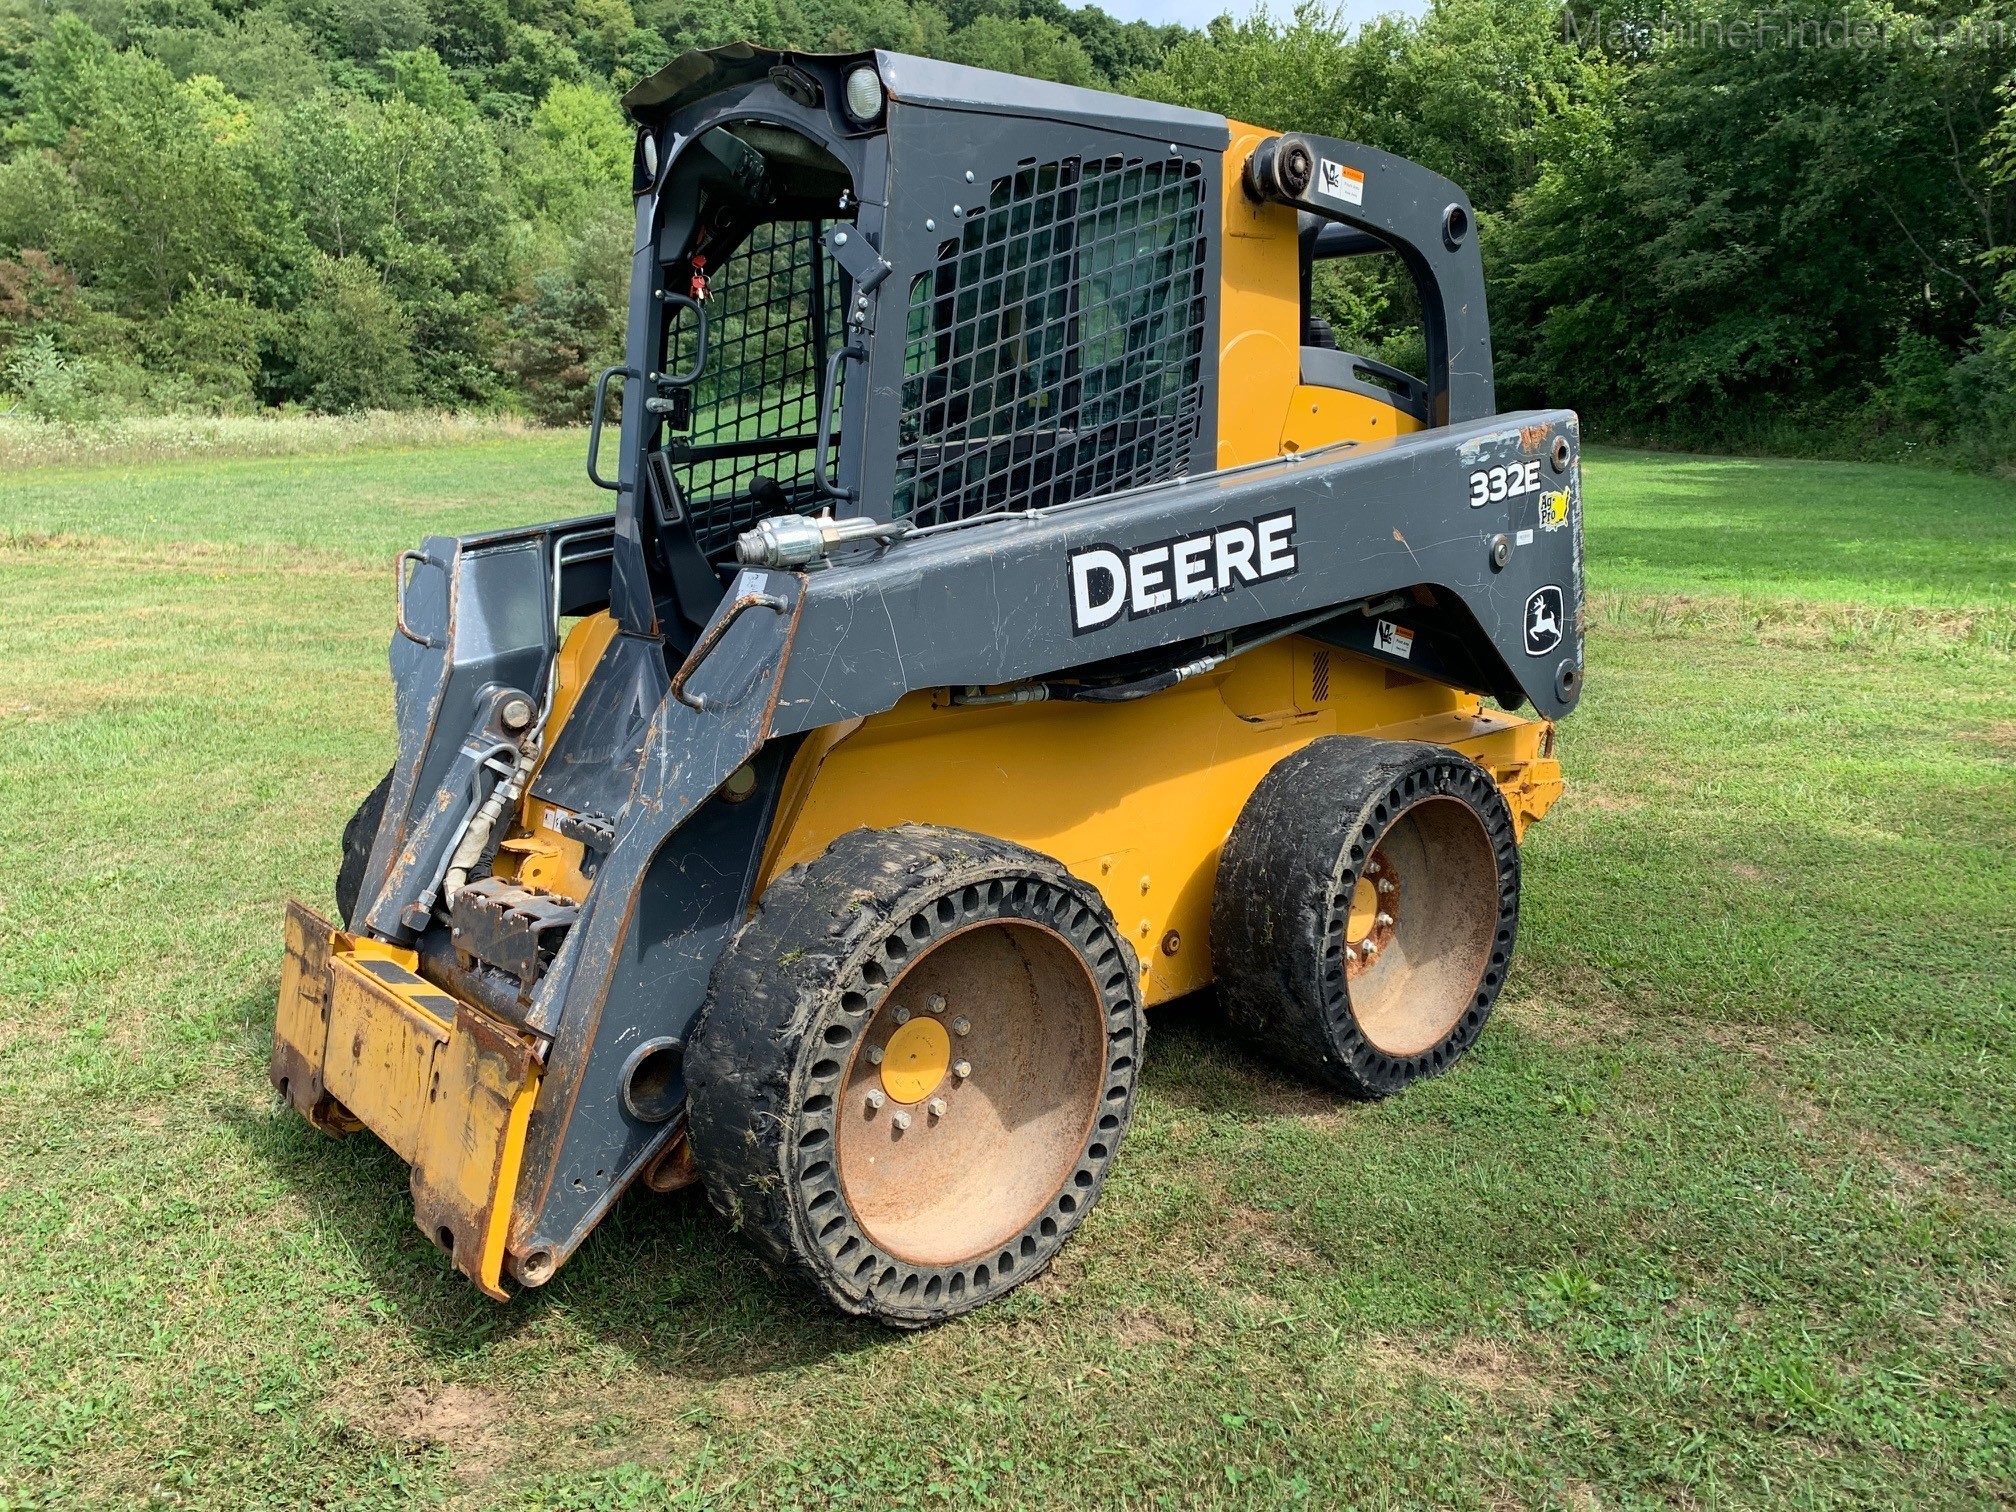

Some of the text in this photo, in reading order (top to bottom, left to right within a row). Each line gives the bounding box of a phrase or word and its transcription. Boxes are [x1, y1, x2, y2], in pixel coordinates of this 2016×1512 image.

[1470, 460, 1541, 508] 332E
[1541, 510, 1556, 525] Pro
[1071, 513, 1296, 630] DEERE
